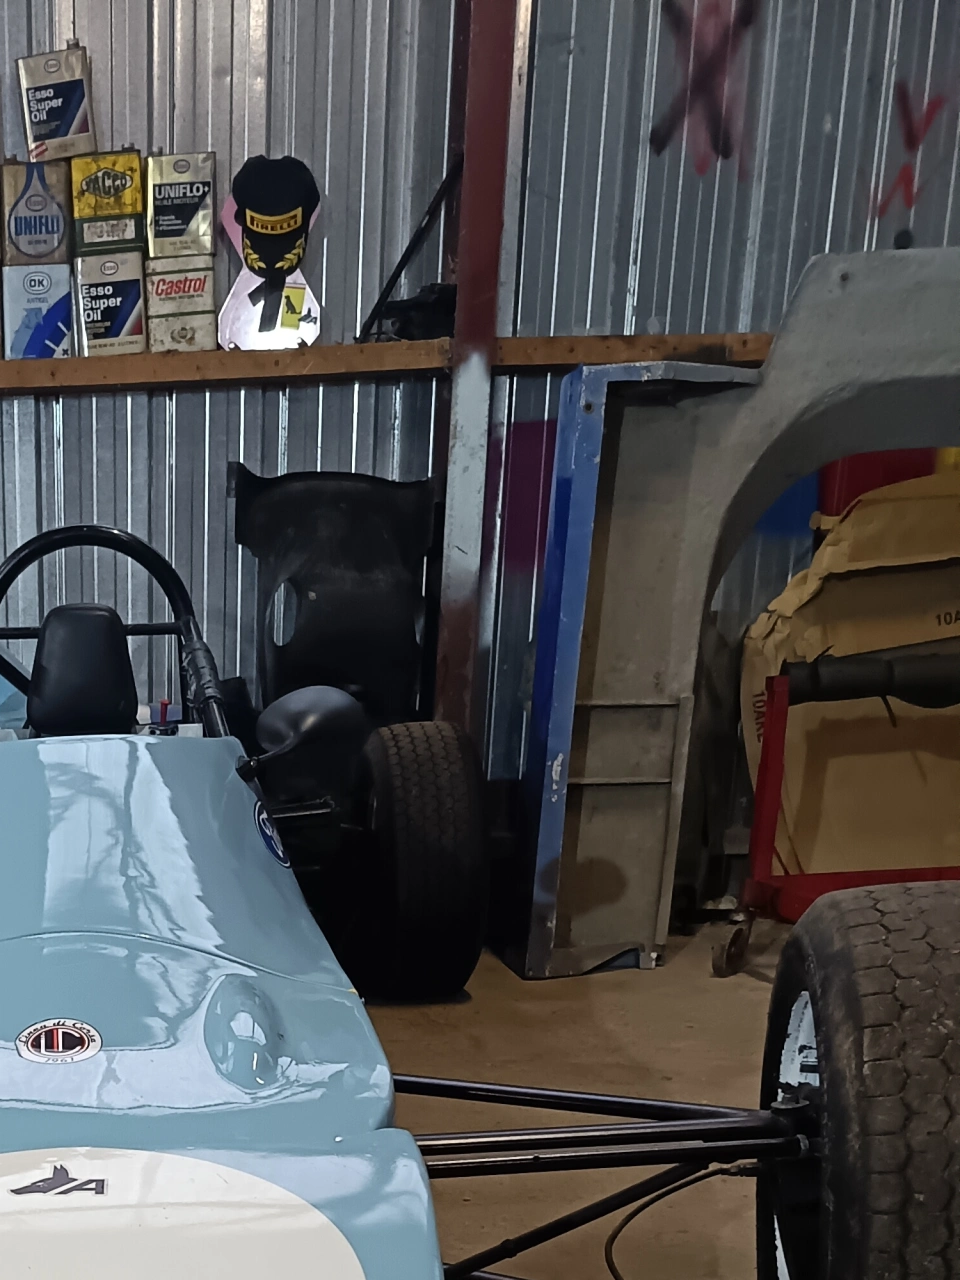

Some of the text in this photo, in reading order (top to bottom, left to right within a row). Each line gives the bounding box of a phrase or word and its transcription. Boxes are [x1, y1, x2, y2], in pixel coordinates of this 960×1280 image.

[28, 88, 54, 101] Esso
[30, 97, 63, 111] Super
[31, 109, 47, 122] Oil
[14, 214, 60, 237] UNIFLO
[249, 213, 298, 232] PIRELLI
[103, 264, 117, 272] Esso
[29, 278, 45, 288] OK
[155, 274, 208, 297] Castrol
[82, 285, 113, 297] Esso
[83, 297, 122, 310] Super
[84, 309, 102, 322] Oil
